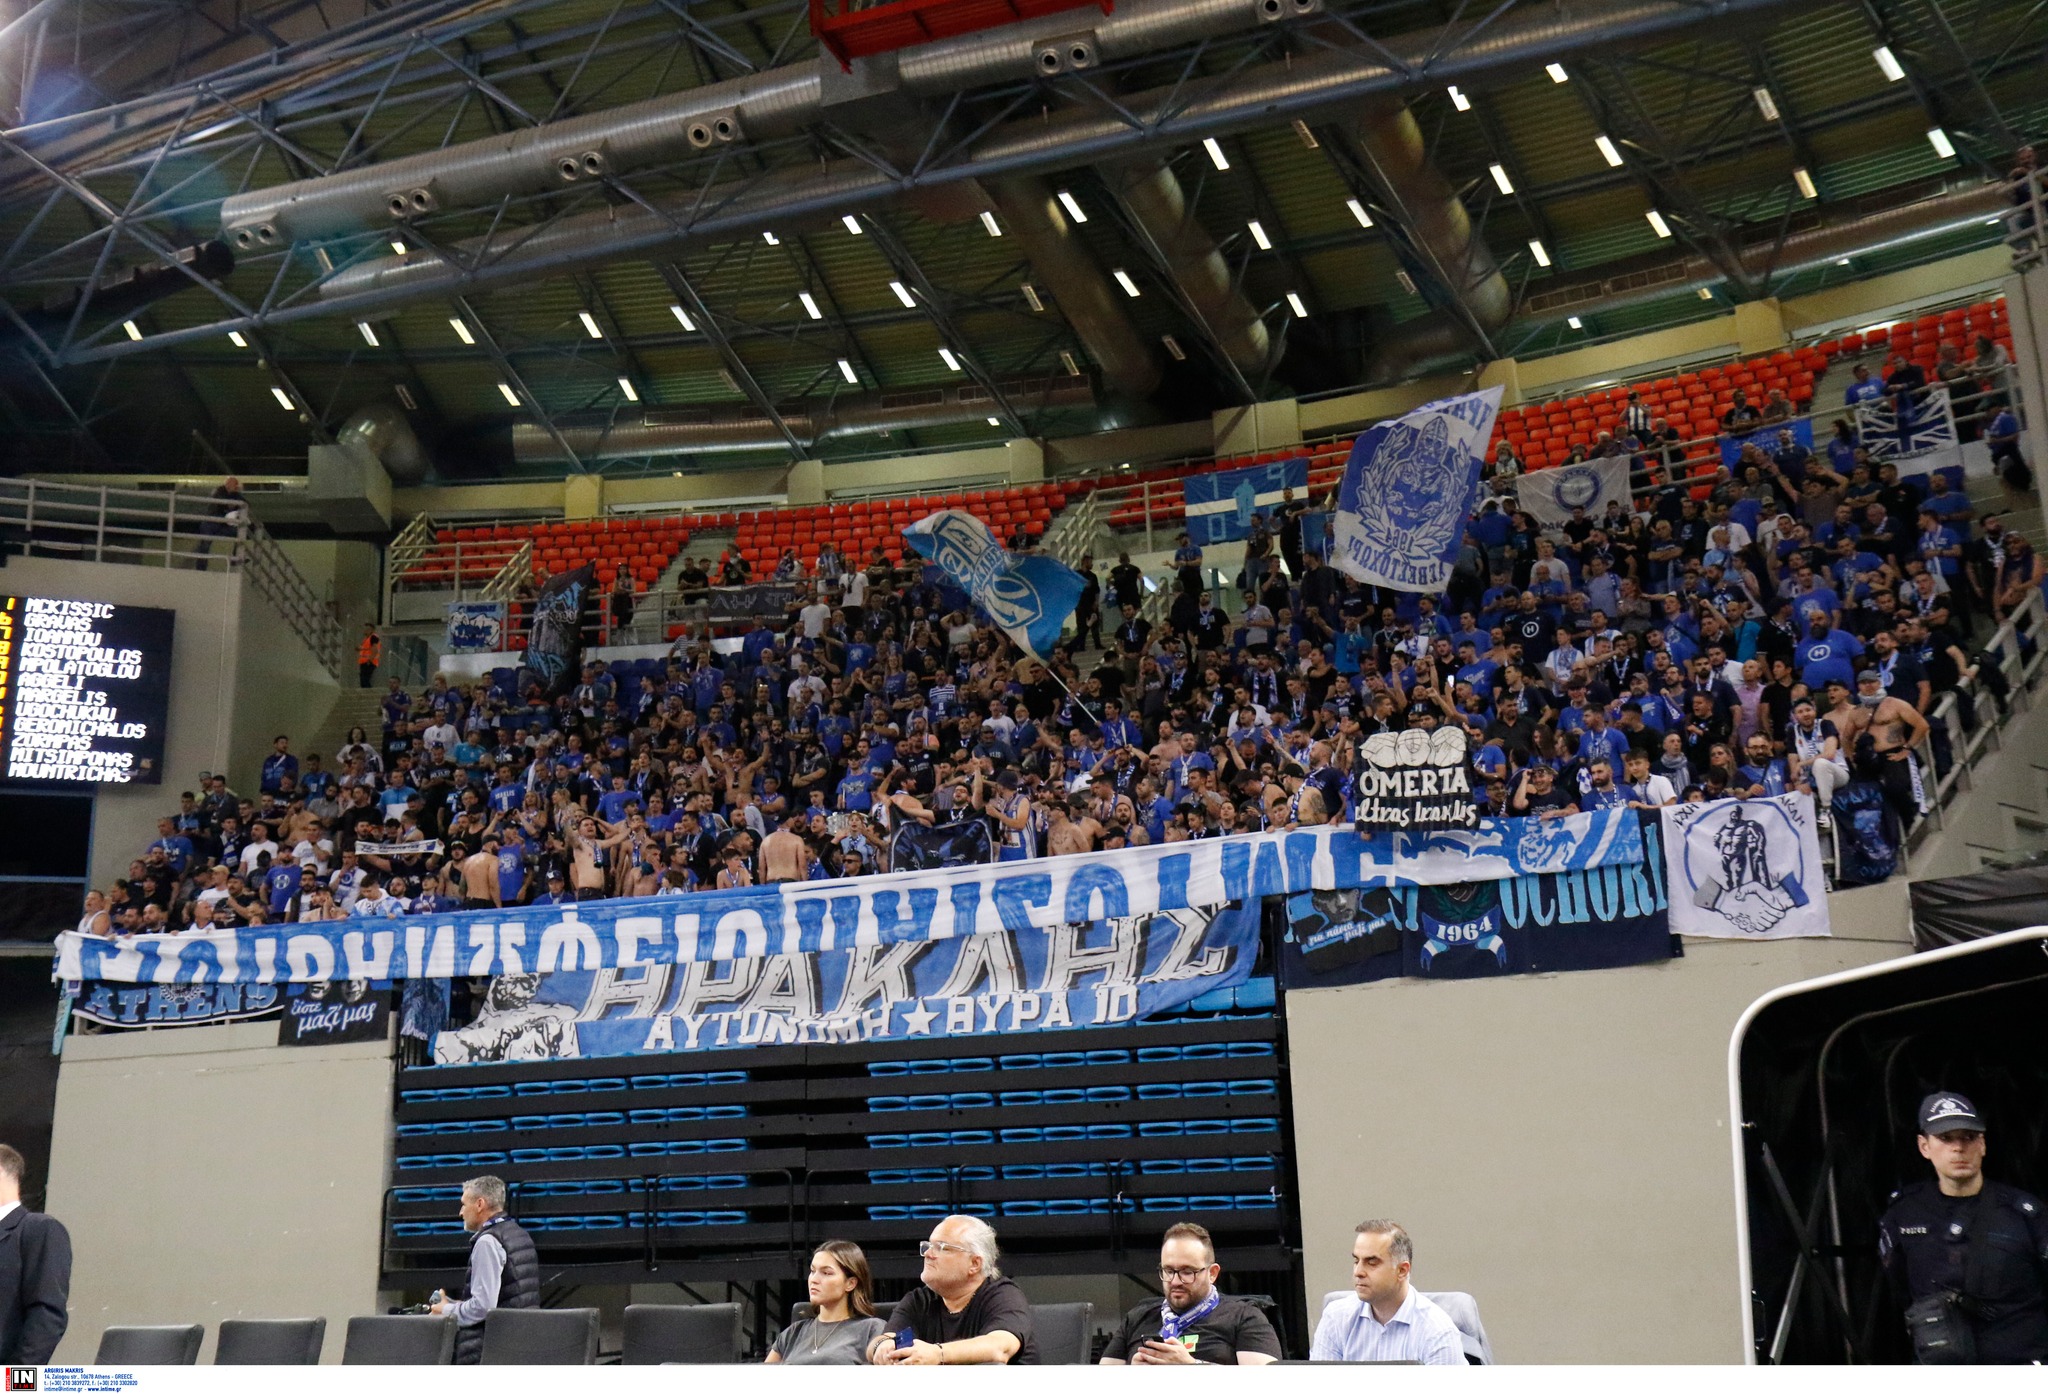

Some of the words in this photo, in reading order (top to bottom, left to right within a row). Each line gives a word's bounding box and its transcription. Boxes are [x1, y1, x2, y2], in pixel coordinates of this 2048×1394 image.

[25, 597, 116, 619] MCKISSIC
[23, 627, 103, 647] IOANNOU
[20, 641, 143, 665] KOSTOPOULOS
[19, 656, 142, 680] MPOLATOGLOU
[17, 671, 86, 691] AGGELI
[16, 685, 108, 707] MARGELIS
[15, 700, 118, 722] UGOCHUKWU
[13, 715, 148, 739] GEROMICHALOS
[11, 731, 93, 751] ZORMPAS
[9, 746, 134, 768] MITSIMPONAS
[1360, 766, 1470, 797] OMERTA
[1436, 915, 1493, 942] 1964
[84, 983, 278, 1022] ATHENS
[946, 992, 1073, 1034] ΘΥΡΑ
[297, 1002, 343, 1039] μαζί
[341, 1002, 378, 1031] μας
